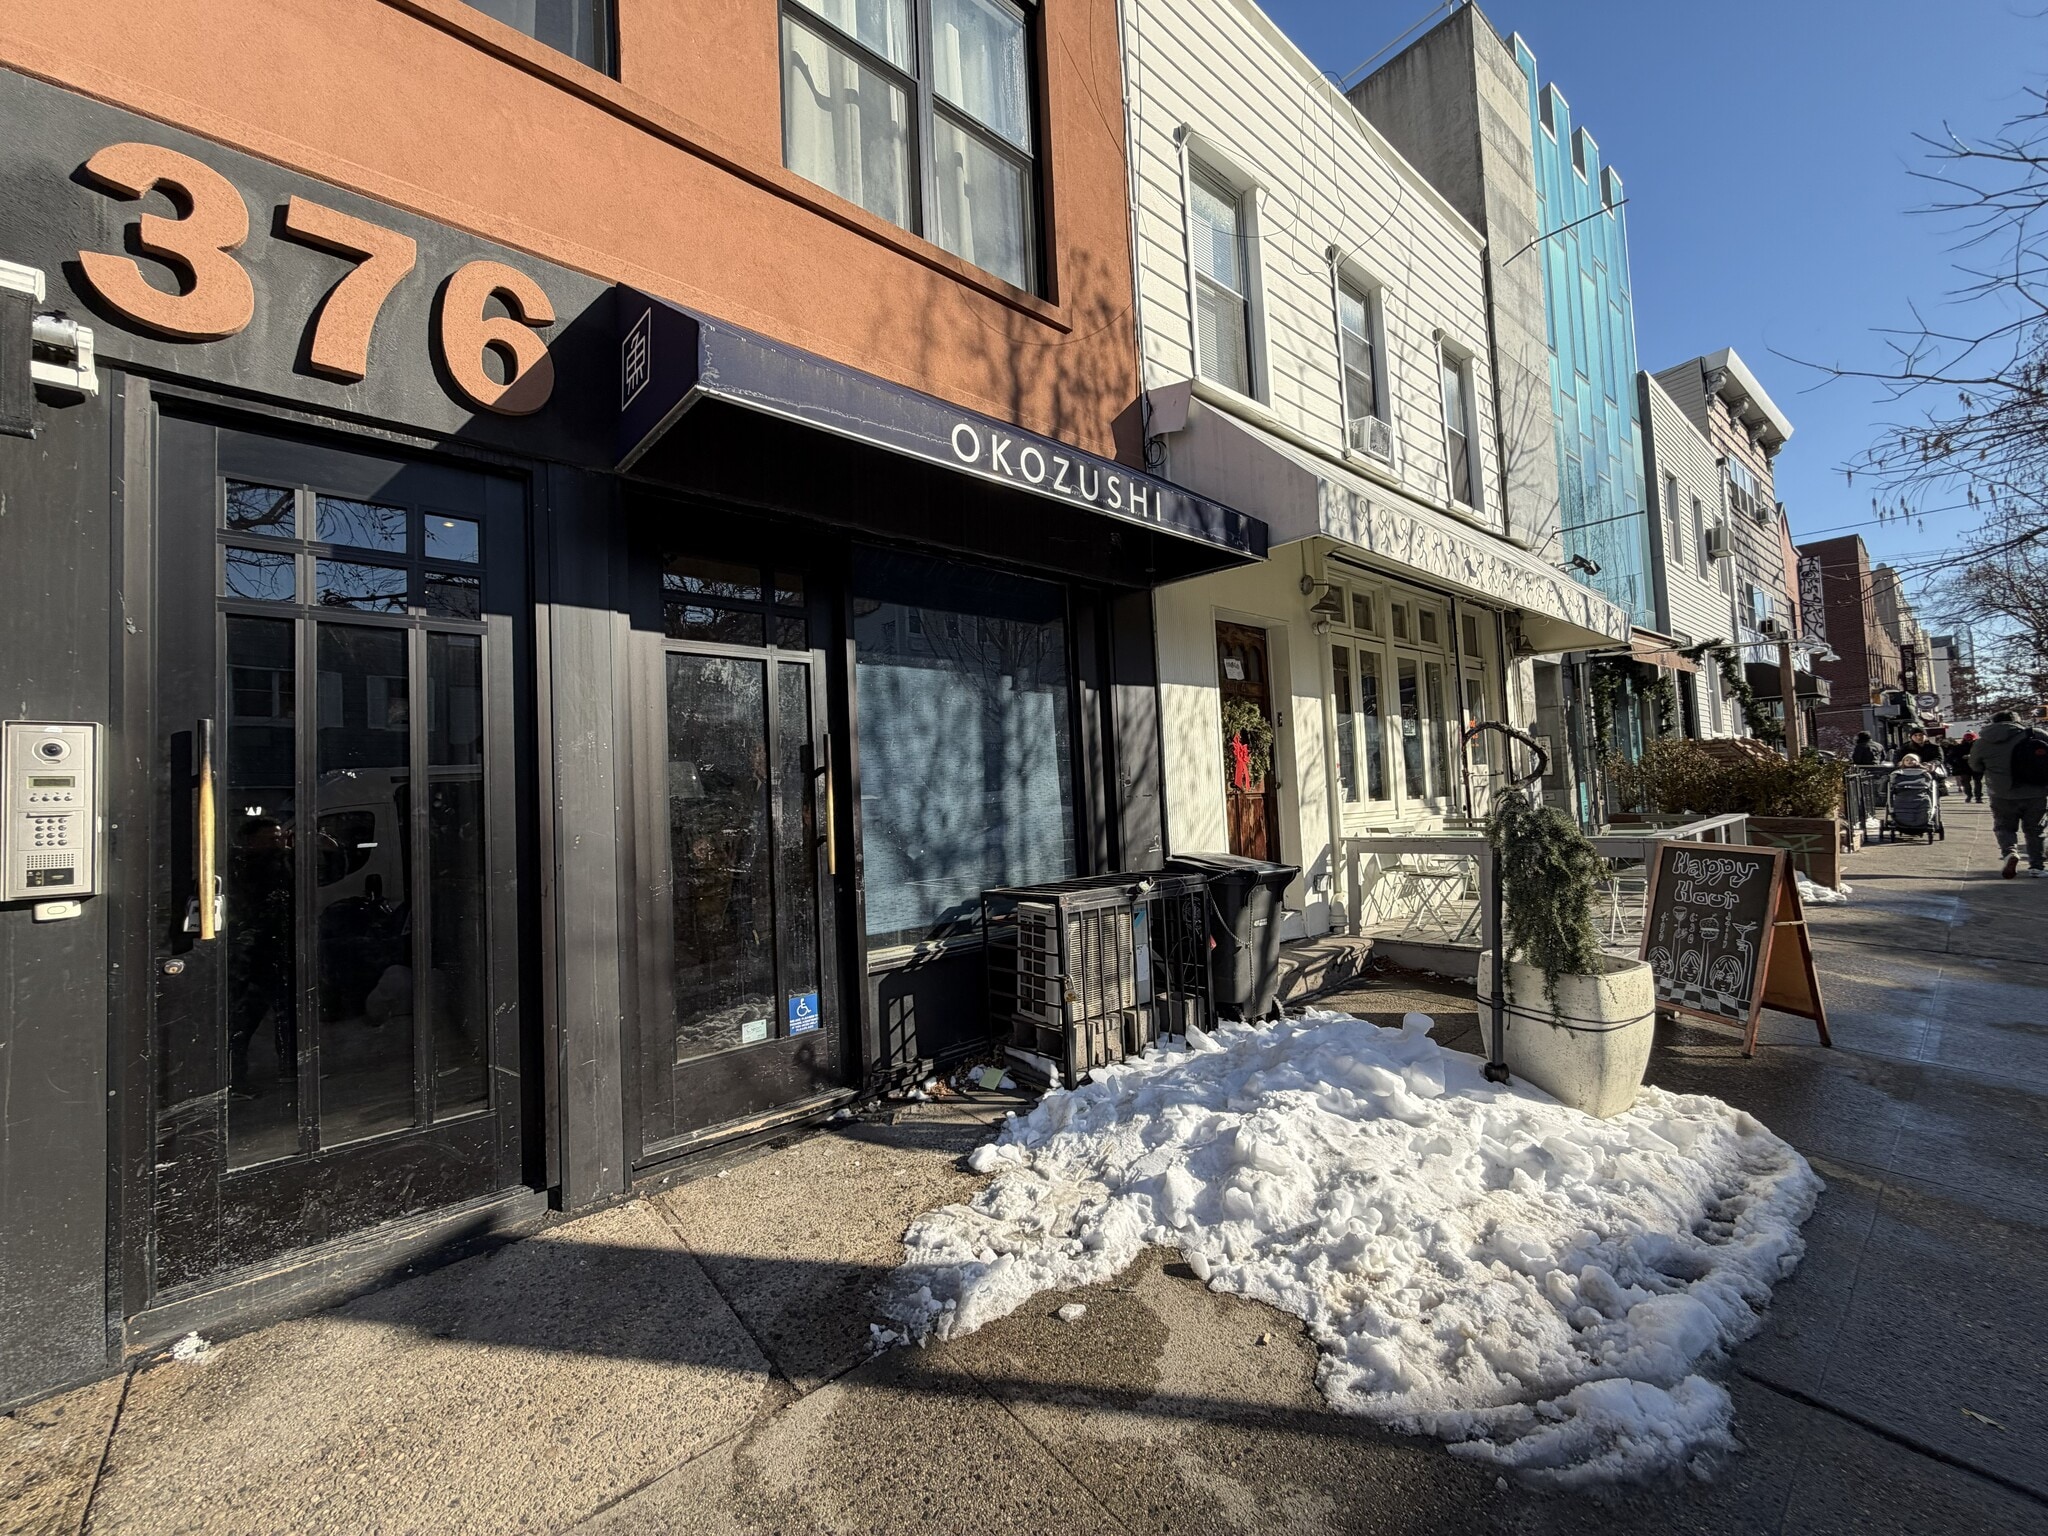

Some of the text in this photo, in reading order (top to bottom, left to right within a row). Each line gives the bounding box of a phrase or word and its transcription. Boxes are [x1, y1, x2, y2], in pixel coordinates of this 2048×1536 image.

[79, 142, 555, 416] 376
[951, 423, 1161, 521] OKOZUSHI
[1672, 851, 1759, 888] Happy
[1674, 880, 1740, 909] Hour
